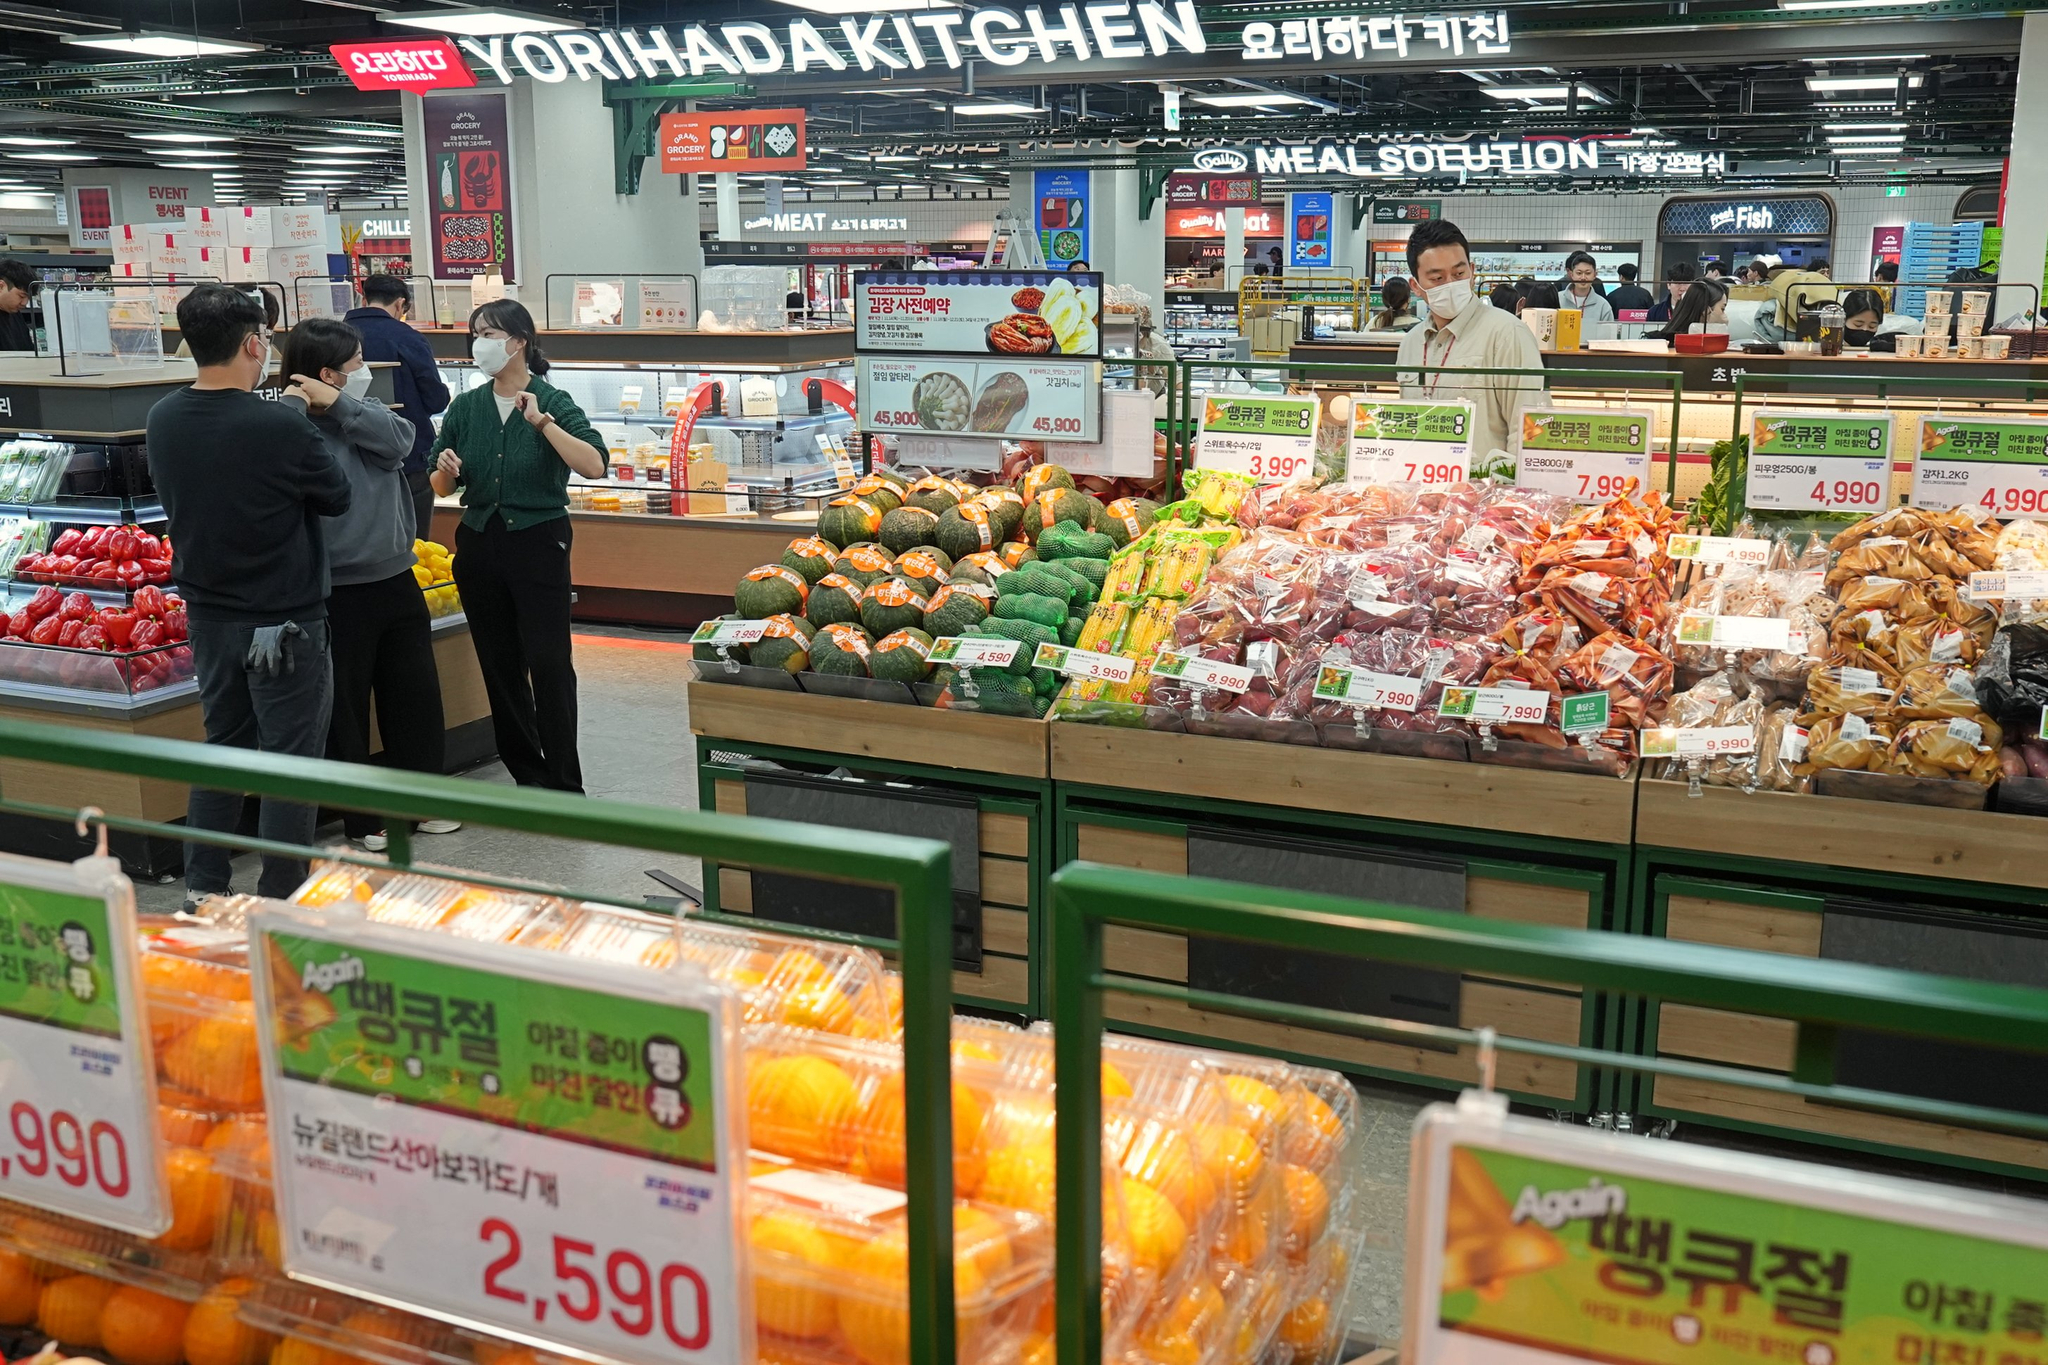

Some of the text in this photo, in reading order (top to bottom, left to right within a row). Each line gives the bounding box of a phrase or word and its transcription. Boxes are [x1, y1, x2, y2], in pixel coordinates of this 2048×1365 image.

[1241, 11, 1511, 60] 요리하다 키친
[382, 73, 437, 82] YORIHADA
[456, 112, 476, 121] GRAND
[451, 122, 480, 130] GROCERY
[673, 133, 699, 143] GRAND
[667, 145, 705, 154] GROCERY
[1201, 152, 1242, 170] Daily
[1255, 140, 1599, 174] MEAL SOLUTION
[149, 186, 189, 200] EVENT
[156, 204, 185, 218] 행사장
[1711, 205, 1773, 229] Fresh Fish
[744, 213, 827, 231] Quality MEAT
[831, 219, 858, 230] 소고기
[1179, 212, 1270, 232] Quality Mat
[82, 231, 109, 241] EVENT
[868, 297, 951, 314] 김장 사전예약
[872, 372, 911, 382] 절임 알타리
[1046, 378, 1069, 388] 갓김치
[1217, 401, 1234, 411] Again
[1366, 405, 1385, 416] Again
[874, 410, 918, 426] 45,900
[1227, 405, 1266, 422] 땡큐절
[1378, 411, 1418, 428] 땡큐절
[1033, 416, 1081, 432] 45,900
[1271, 419, 1284, 427] 미친
[1285, 420, 1298, 428] 할인
[1535, 415, 1554, 427] Again
[1766, 420, 1787, 431] Again
[1425, 424, 1437, 432] 미친
[1439, 425, 1452, 433] 할인
[1548, 421, 1591, 438] 땡큐절
[1598, 425, 1613, 433] 아침
[1780, 426, 1827, 443] 땡큐절
[1835, 428, 1851, 438] 아침
[1936, 424, 1958, 436] Again
[1597, 435, 1612, 443] 미친
[1613, 435, 1628, 444] 할인
[1834, 439, 1850, 448] 미친
[1851, 439, 1867, 449] 할인
[1950, 429, 2000, 449] 땡큐절
[2009, 433, 2026, 443] 아침
[1204, 440, 1262, 451] 스위트옥수수/2입
[2007, 445, 2042, 455] 미친 할인
[1250, 455, 1308, 480] 3,990
[1525, 457, 1574, 469] 당근800G/봉
[1922, 469, 1969, 481] 감자1.2KG
[1810, 480, 1880, 506] 4,990
[1979, 487, 2048, 515] 4,990
[1727, 550, 1765, 562] 4,990
[977, 652, 1011, 663] 4,590
[1090, 664, 1128, 681] 3,990
[1207, 673, 1246, 690] 8,990
[1375, 689, 1415, 706] 7,990
[1501, 705, 1542, 720] 7,990
[1707, 738, 1750, 751] 9,990
[302, 953, 365, 992] Again
[347, 979, 501, 1067] 땡큐절
[527, 1021, 580, 1058] 아침
[531, 1063, 585, 1101] 미친
[589, 1072, 643, 1115] 할인
[292, 1112, 558, 1208] 뉴질랜드산아보카도/개
[1510, 1176, 1627, 1229] Again
[1588, 1212, 1850, 1335] 땡큐절
[480, 1216, 711, 1351] 2,590
[1903, 1279, 1994, 1333] 아침
